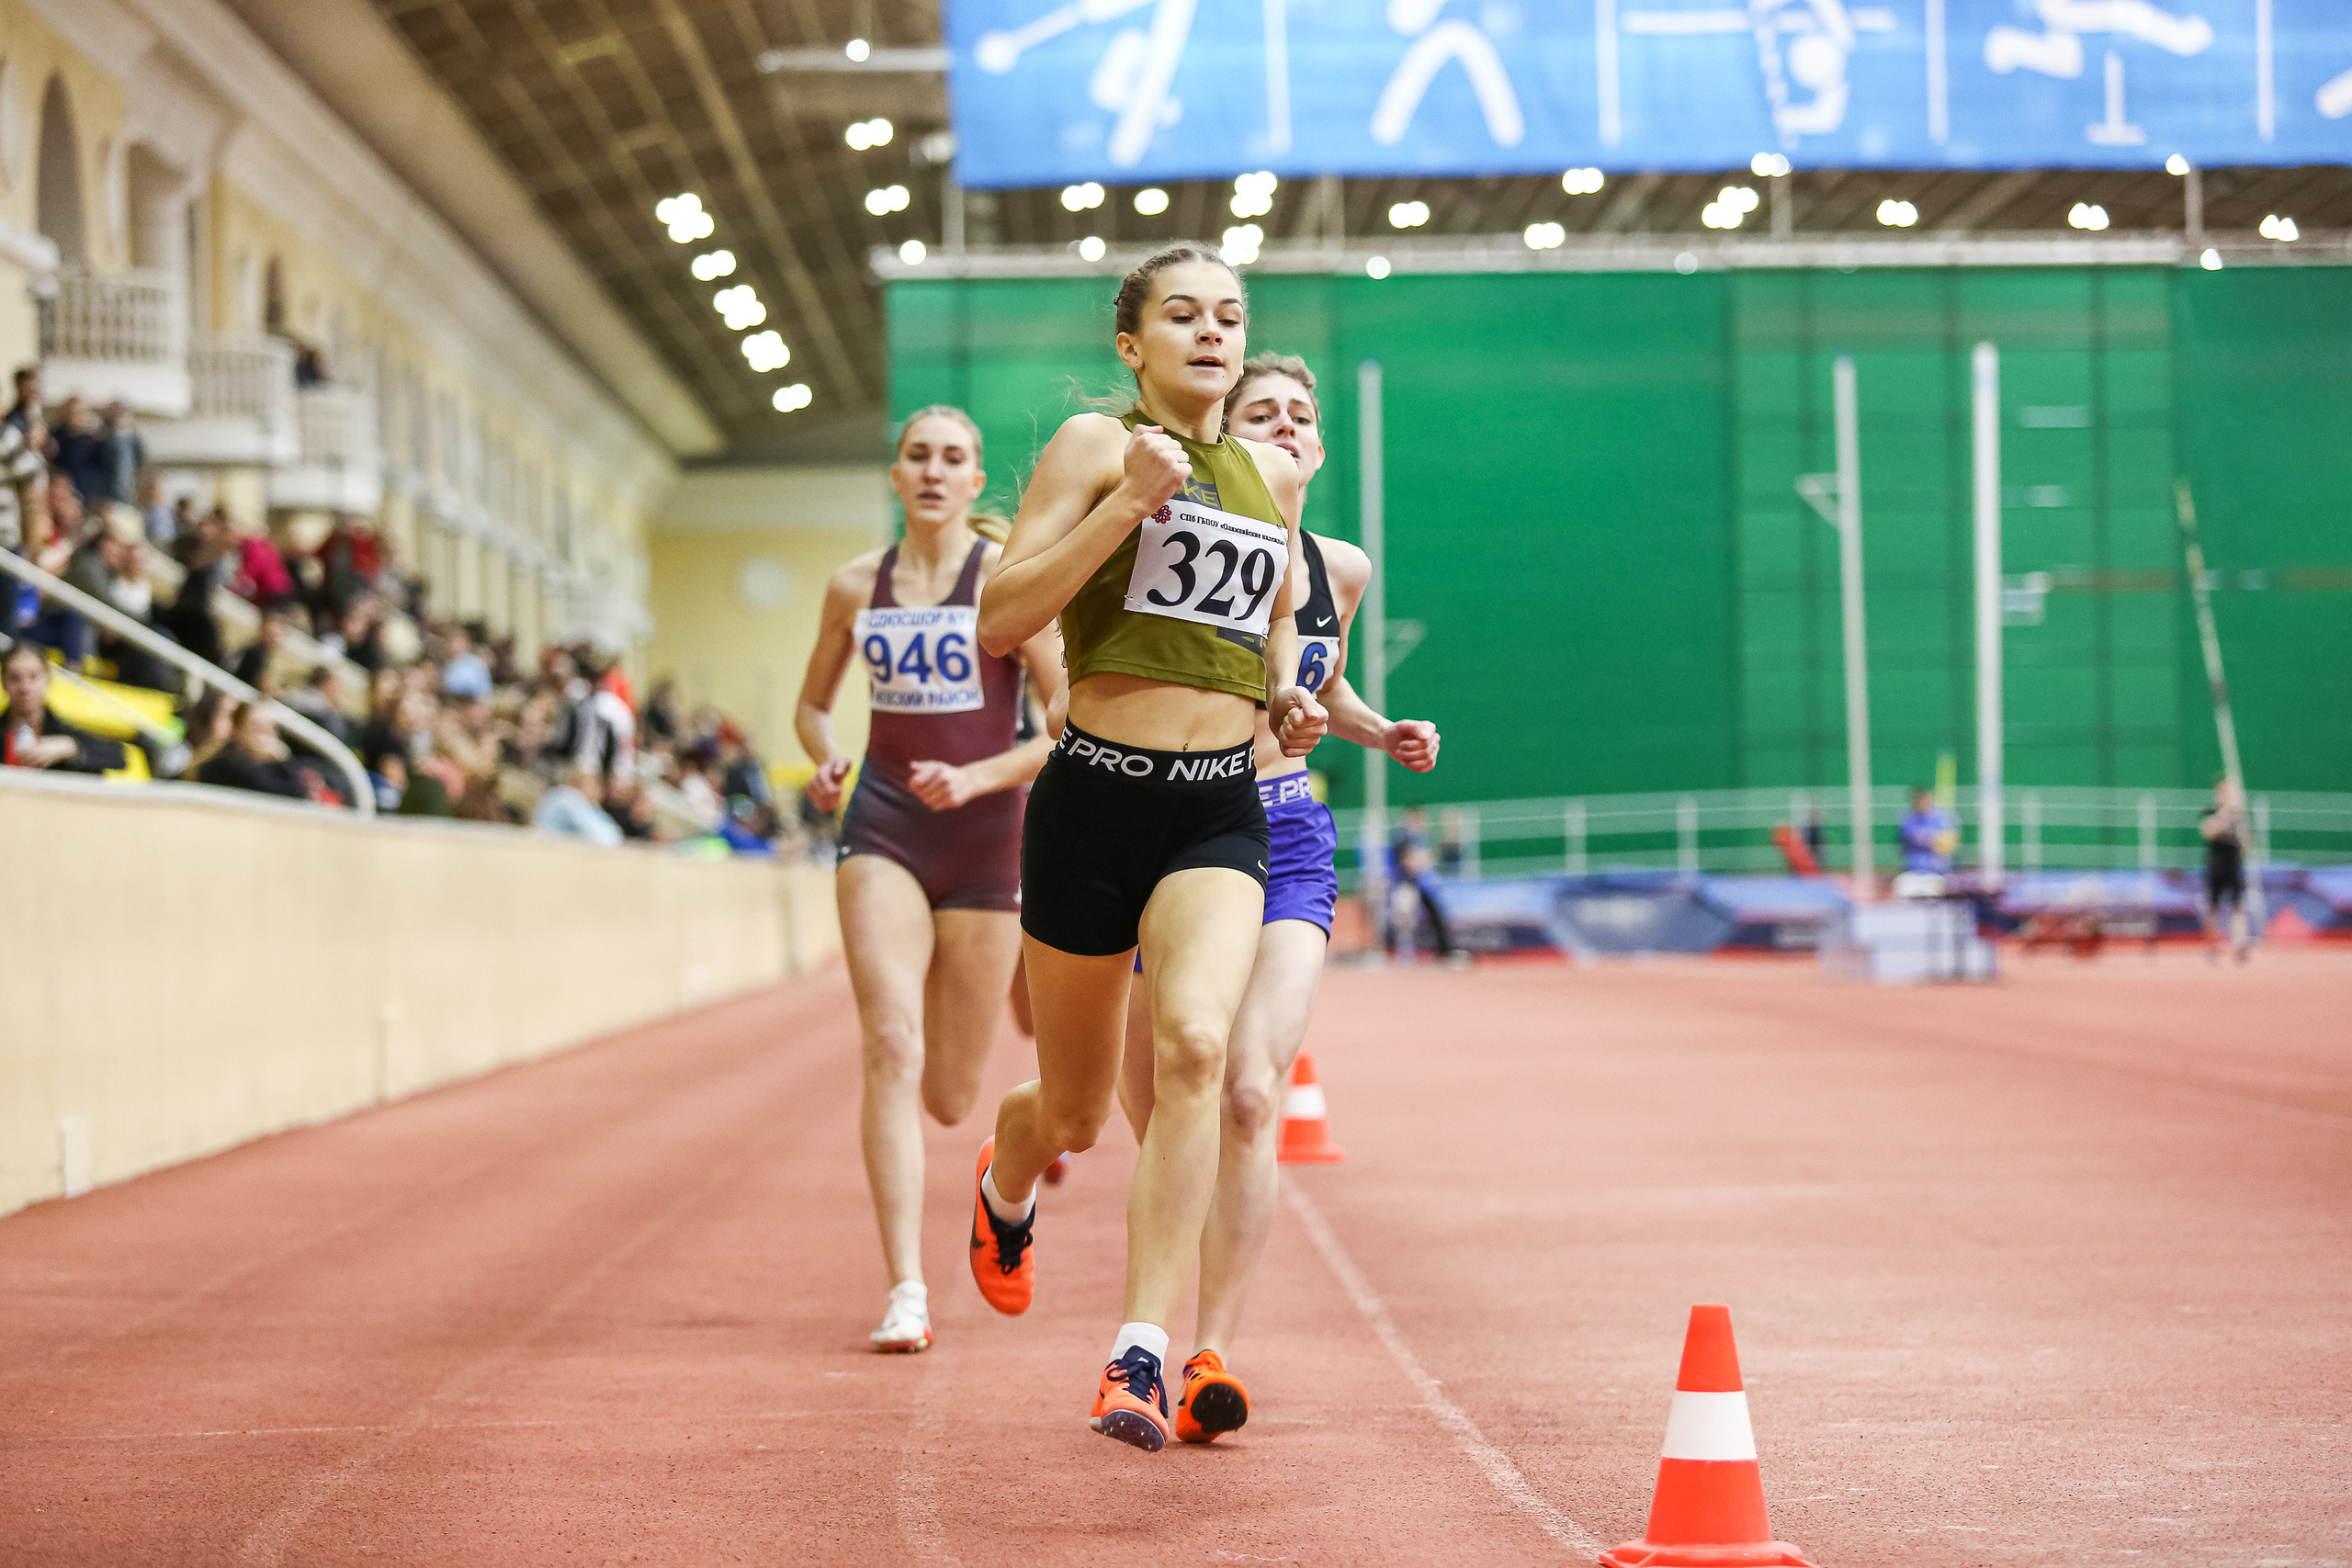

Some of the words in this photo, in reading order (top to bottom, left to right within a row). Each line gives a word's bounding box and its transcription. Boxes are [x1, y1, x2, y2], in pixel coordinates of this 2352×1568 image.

[1177, 482, 1218, 507] KE
[1146, 530, 1276, 621] 329
[864, 632, 972, 683] 946
[1067, 737, 1154, 777] PRO
[1167, 750, 1247, 781] NIKE
[1280, 775, 1311, 804] PR
